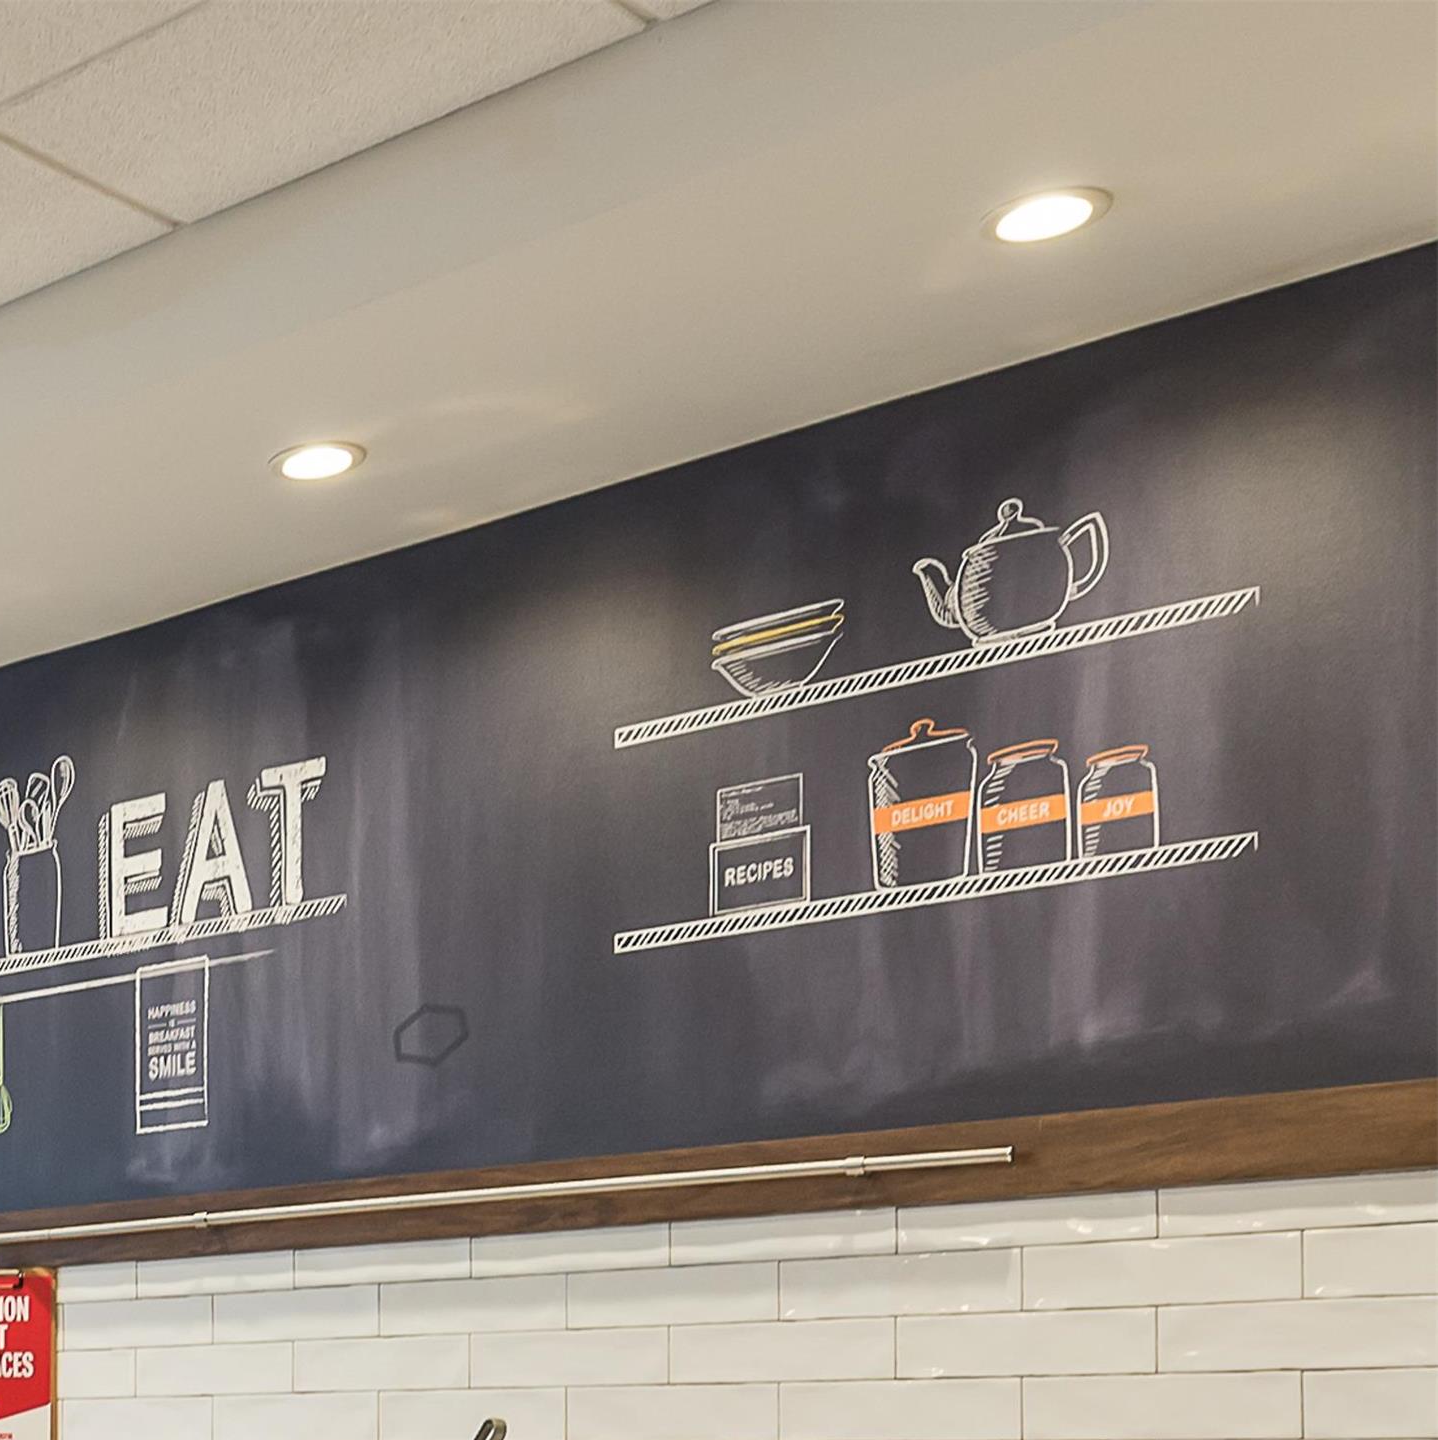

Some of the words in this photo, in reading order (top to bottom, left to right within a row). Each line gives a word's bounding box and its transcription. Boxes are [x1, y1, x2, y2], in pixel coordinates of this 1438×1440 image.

[891, 800, 953, 827] DELIGHT
[996, 802, 1051, 826] CHEER
[1102, 797, 1135, 818] JOY
[99, 756, 326, 940] EAT
[724, 857, 794, 887] RECIPES
[147, 999, 196, 1019] HAPPINESS
[148, 1025, 195, 1046] BREAKFAST
[148, 1050, 196, 1081] SMILE
